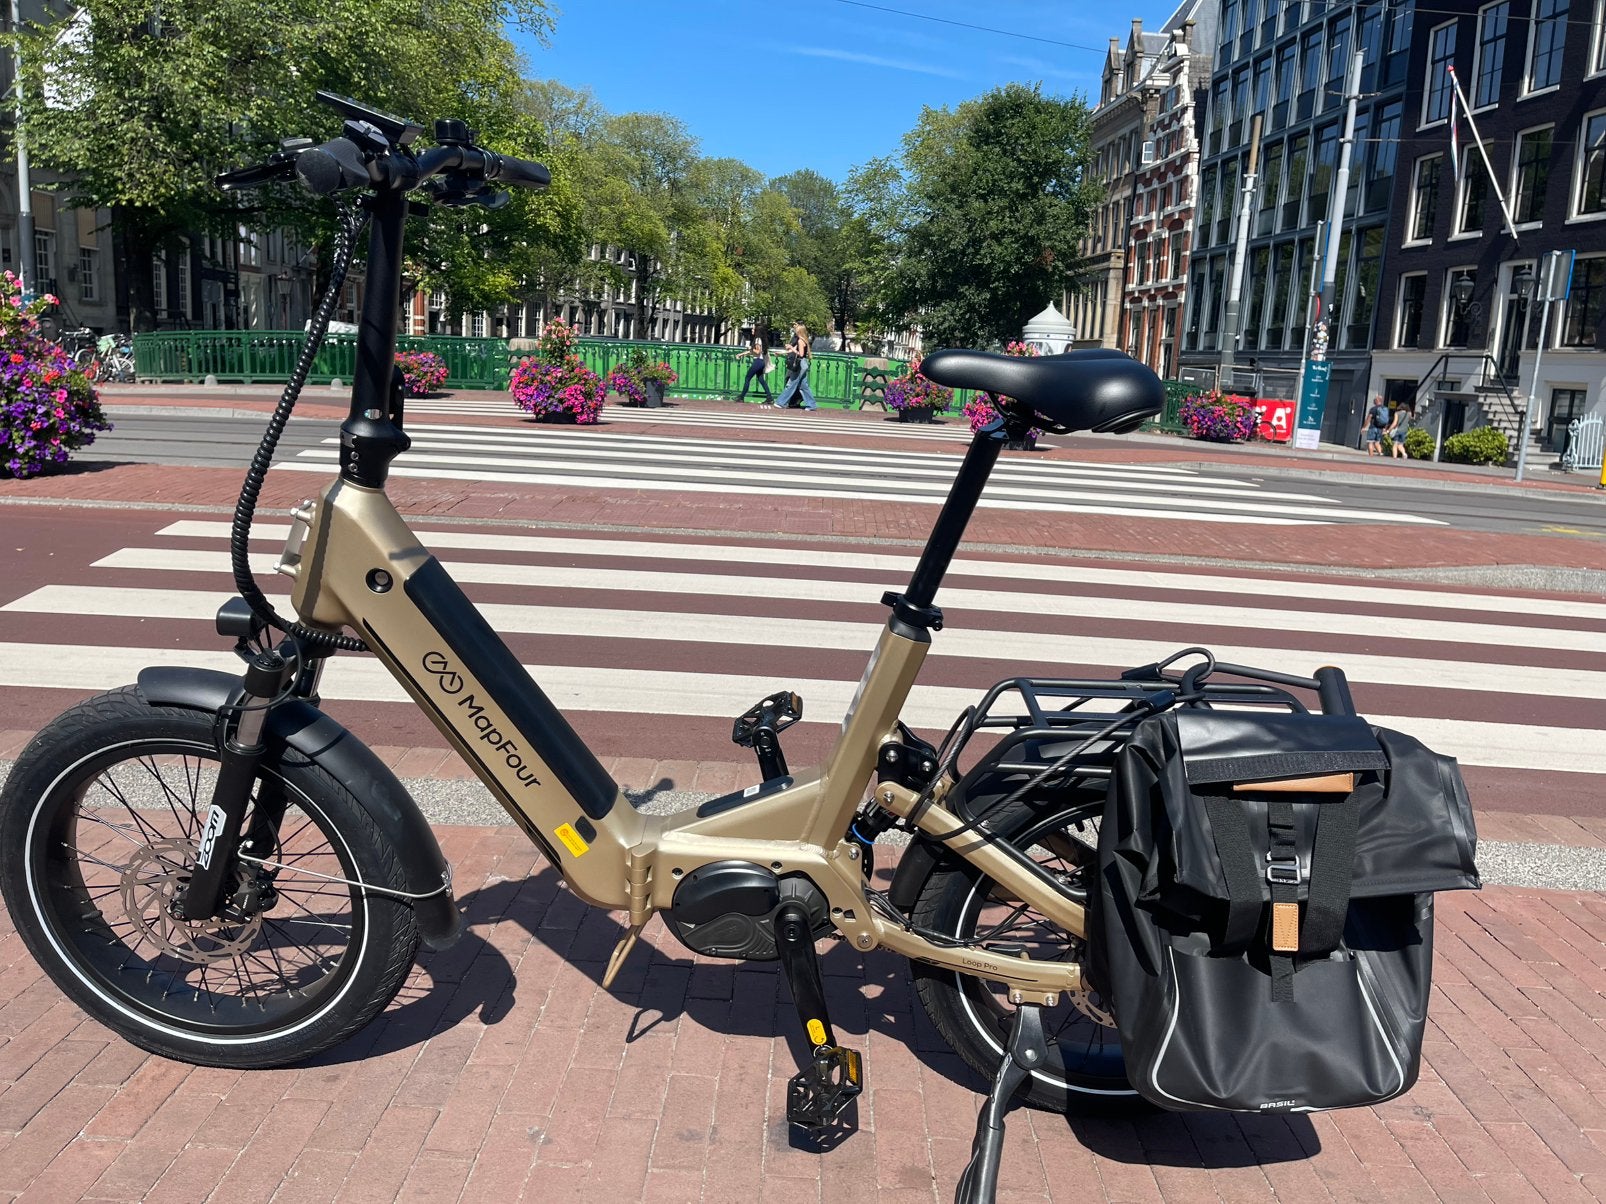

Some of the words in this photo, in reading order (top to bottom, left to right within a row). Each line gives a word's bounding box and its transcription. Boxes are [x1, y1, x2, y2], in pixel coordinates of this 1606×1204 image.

[458, 694, 541, 788] MapFour
[962, 957, 983, 969] Loop
[983, 962, 999, 972] Pro
